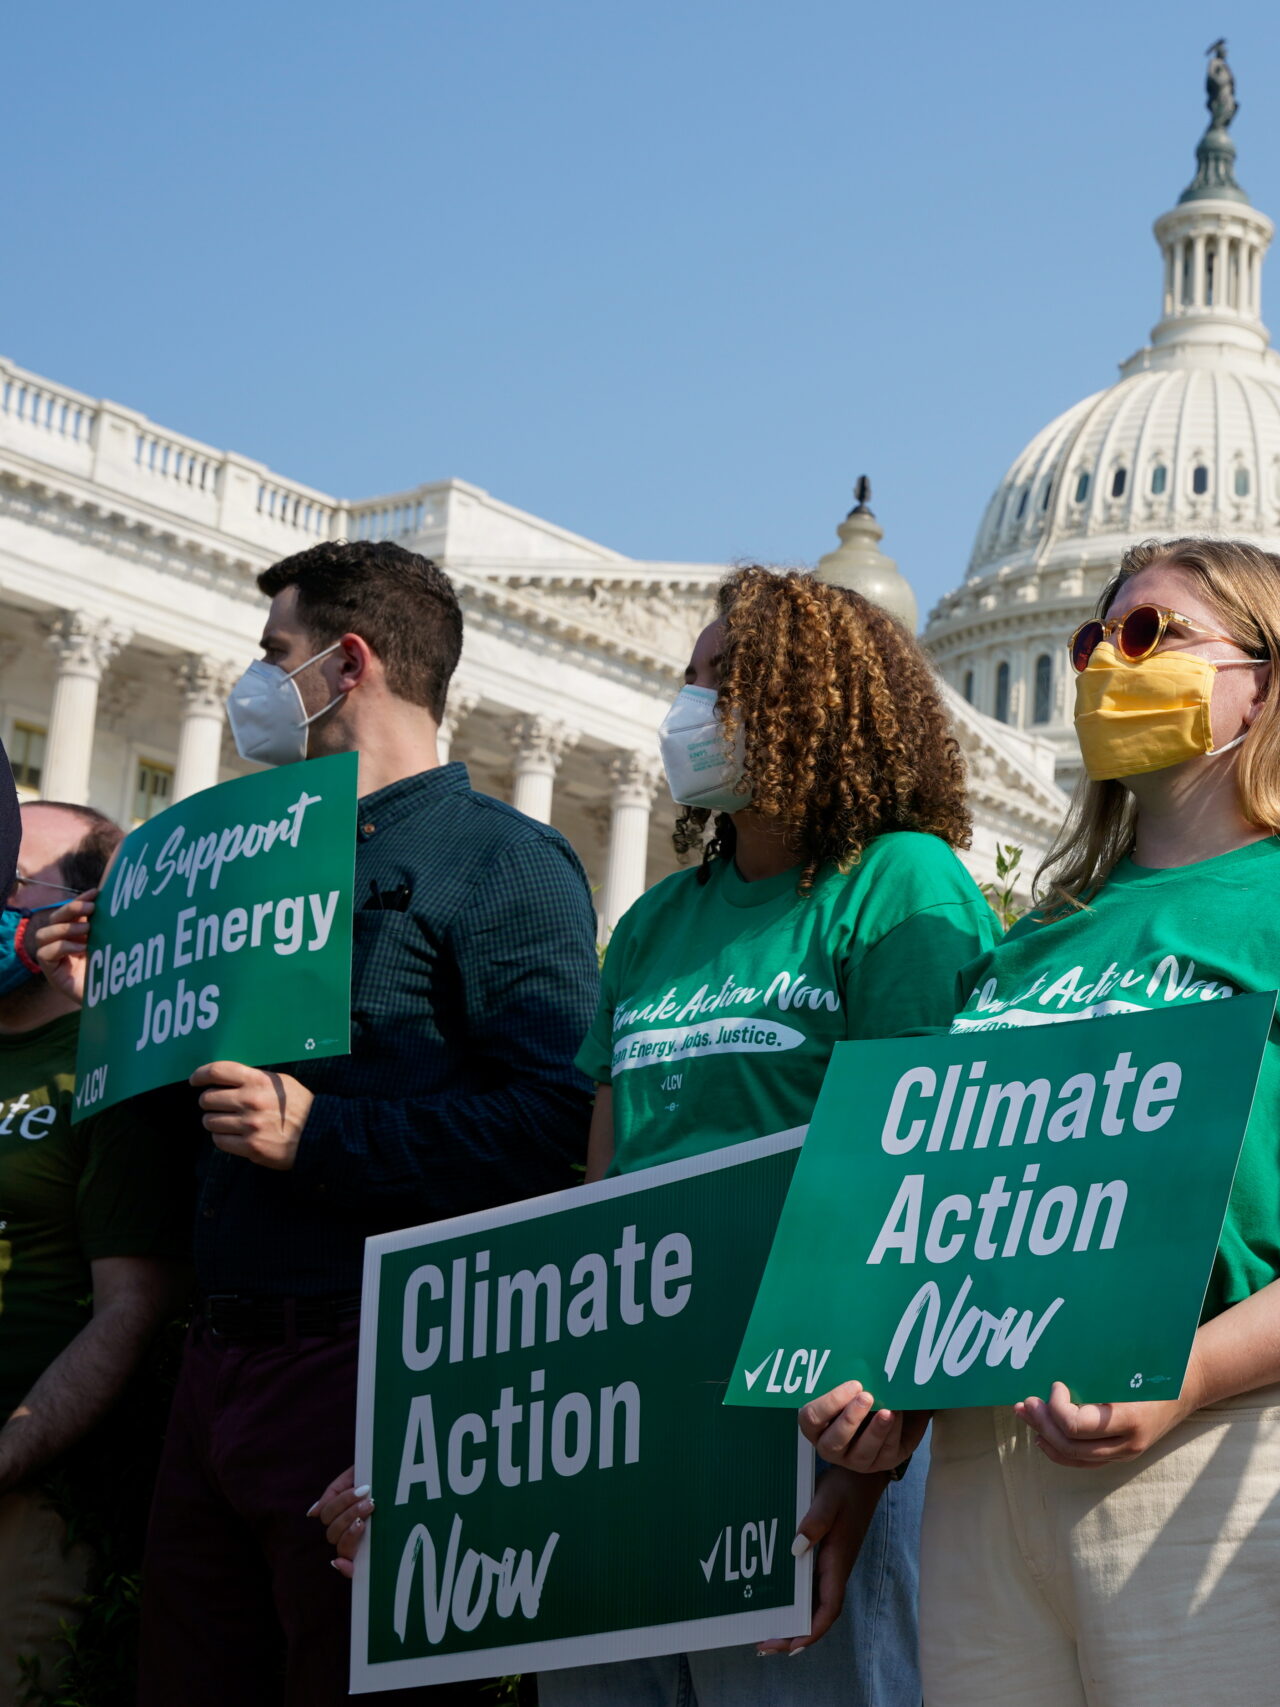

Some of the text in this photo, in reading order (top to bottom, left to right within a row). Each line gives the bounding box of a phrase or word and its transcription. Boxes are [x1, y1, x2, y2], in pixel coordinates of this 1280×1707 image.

[111, 792, 322, 917] We Support
[88, 891, 339, 1007] Clean Energy
[675, 975, 763, 1022] Action
[763, 971, 840, 1012] Now
[136, 979, 219, 1051] Jobs
[629, 1040, 677, 1058] Energy.
[681, 1031, 712, 1050] Jobs.
[716, 1026, 782, 1046] Justice.
[84, 1065, 108, 1107] LCV
[667, 1074, 683, 1090] LCV
[881, 1052, 1181, 1155] Climate
[866, 1164, 1127, 1264] Action
[402, 1225, 692, 1371] Climate
[884, 1275, 1064, 1385] Now
[768, 1349, 831, 1394] LCV
[395, 1369, 640, 1505] Action
[394, 1513, 560, 1644] Now
[725, 1518, 778, 1582] LCV
